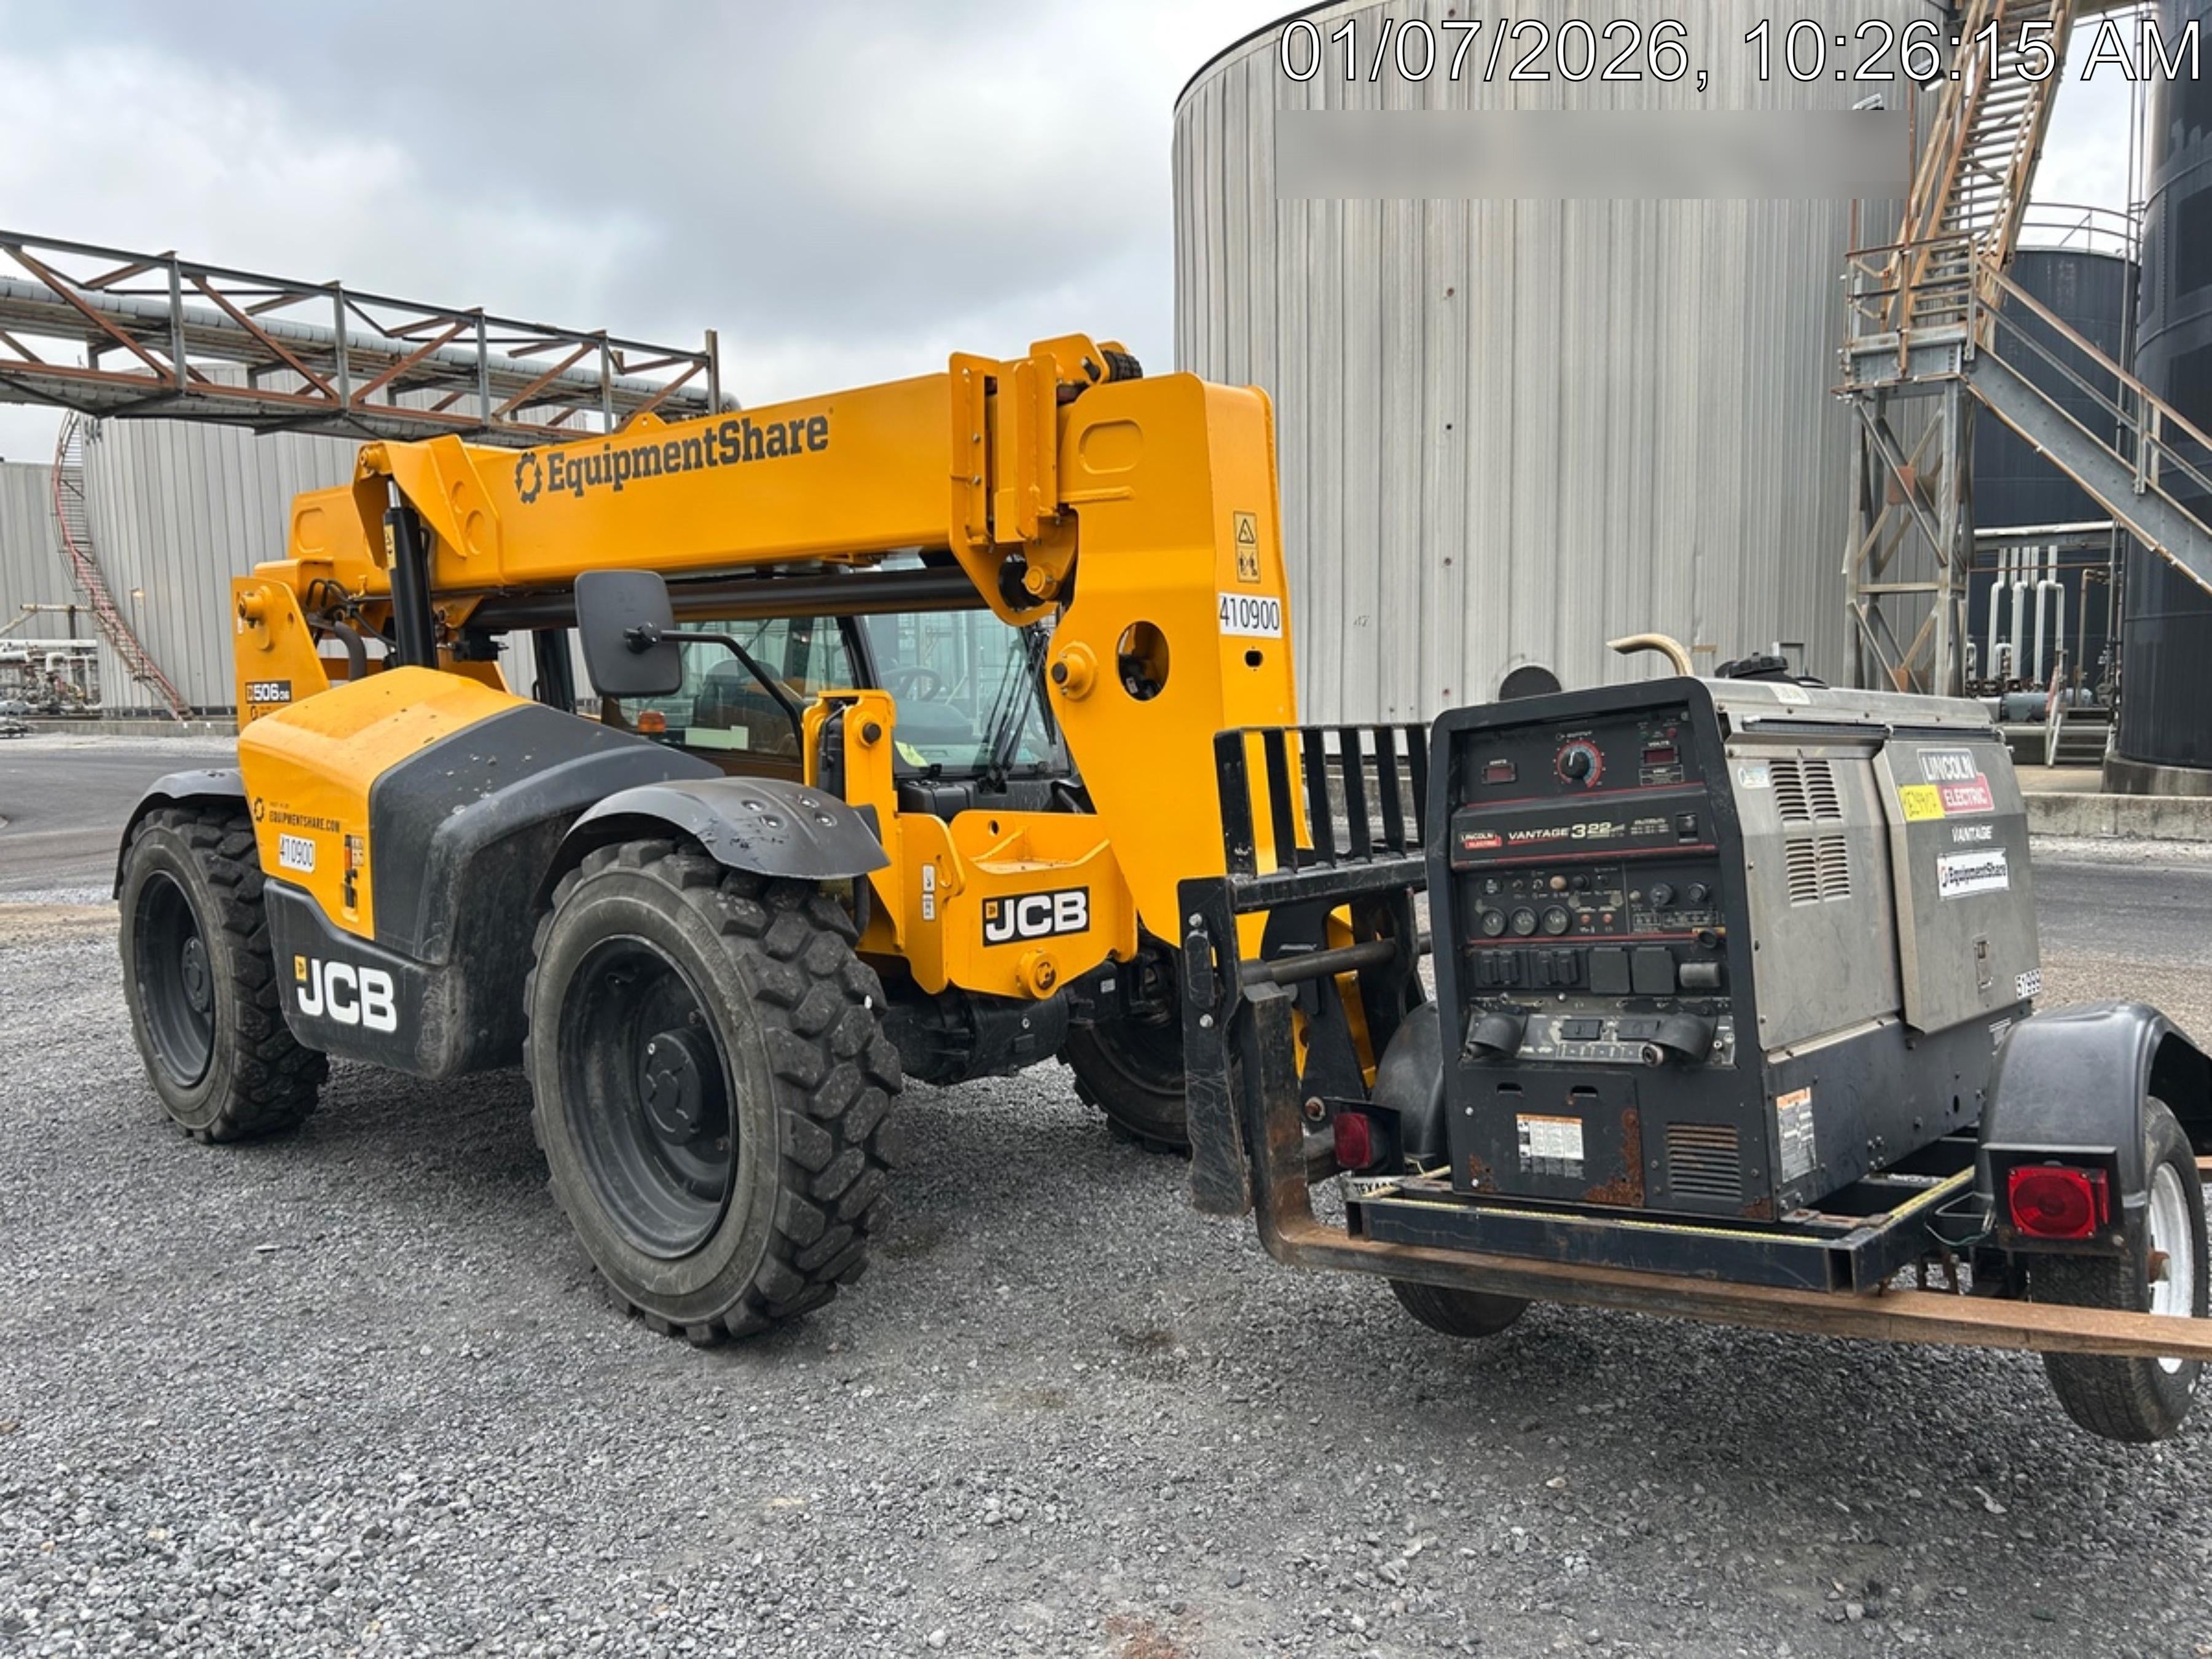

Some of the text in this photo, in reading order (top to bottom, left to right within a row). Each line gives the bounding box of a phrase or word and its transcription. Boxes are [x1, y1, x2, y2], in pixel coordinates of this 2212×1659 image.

[546, 414, 829, 498] EquipmentShare
[1219, 596, 1280, 632] 410900
[1922, 756, 1977, 781] LINCOLN
[1943, 786, 1988, 806] ELECTRIC
[269, 810, 340, 833] EQUIPMENTSHARE.COM
[1508, 827, 1569, 840] VANTAGE
[1951, 825, 1993, 843] VANTAGE
[280, 836, 313, 867] 410900
[986, 890, 1087, 942] JCB
[297, 958, 397, 1033] JCB
